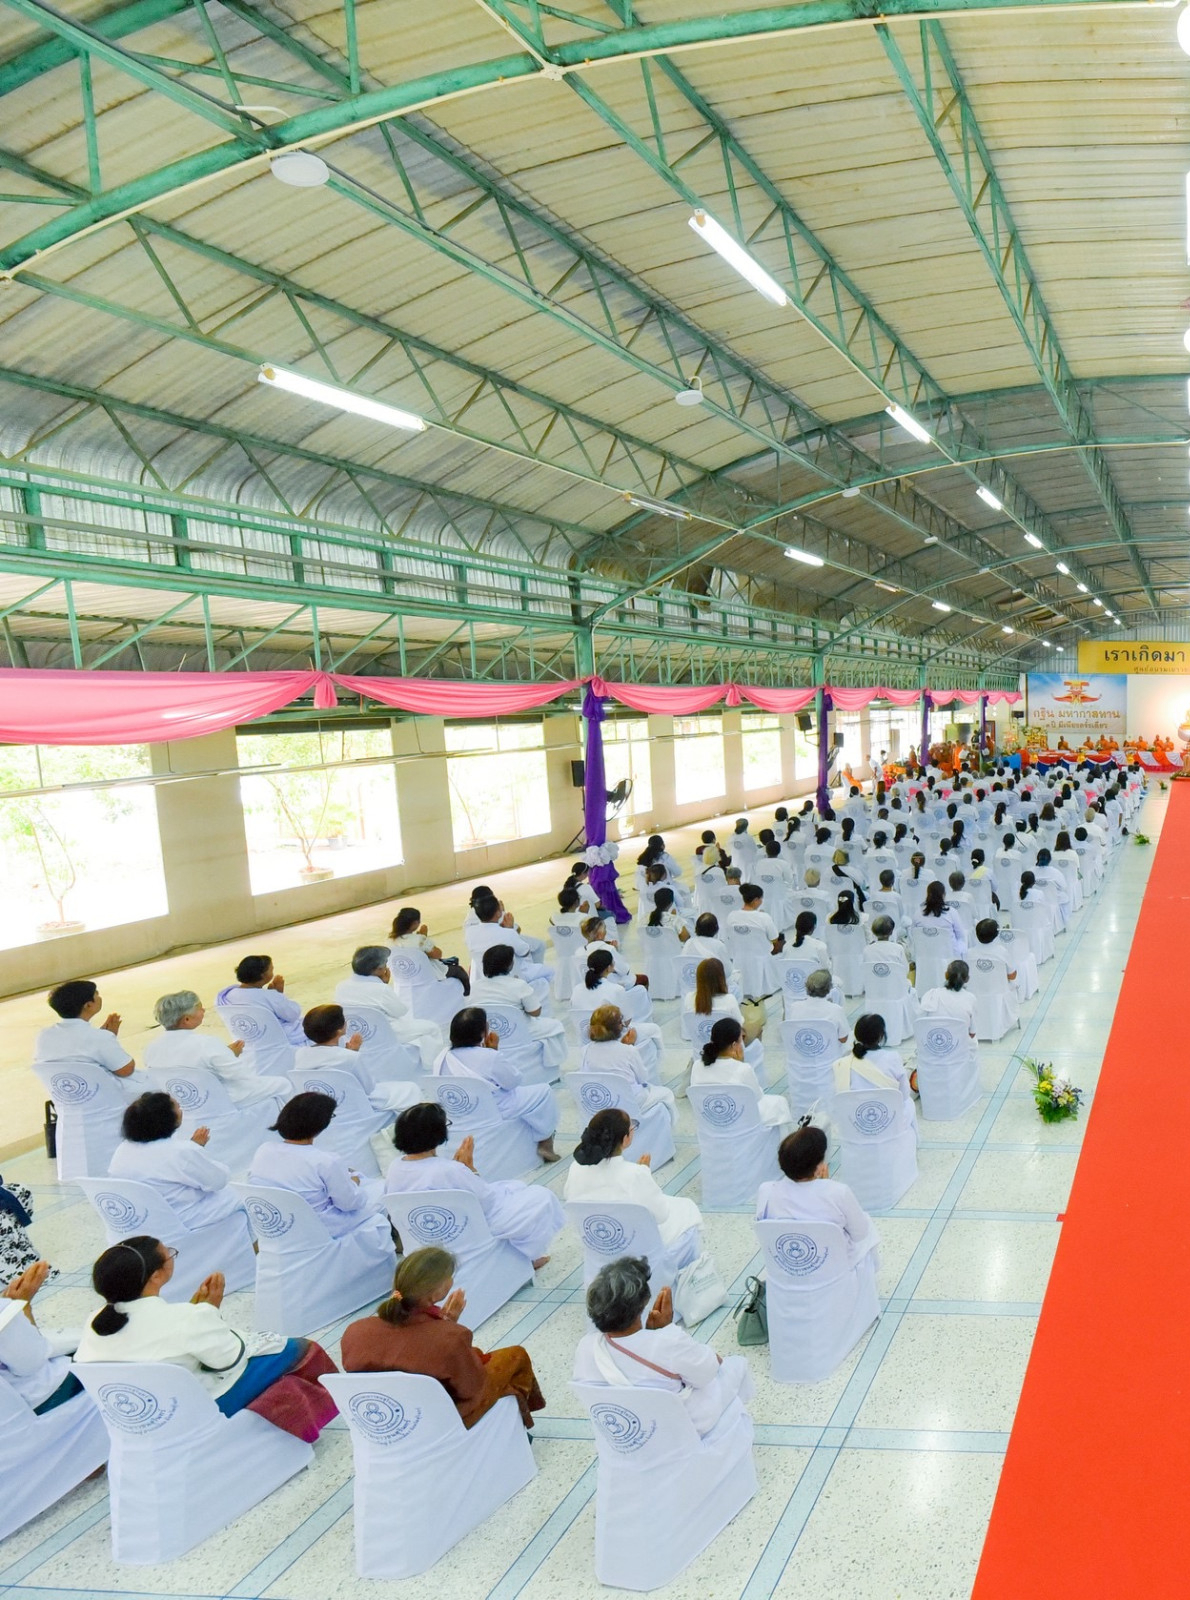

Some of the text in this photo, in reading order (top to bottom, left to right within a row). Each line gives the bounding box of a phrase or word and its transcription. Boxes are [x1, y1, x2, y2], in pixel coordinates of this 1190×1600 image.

[1104, 644, 1185, 662] เราเกิดมา
[1033, 707, 1055, 720] กฐิน
